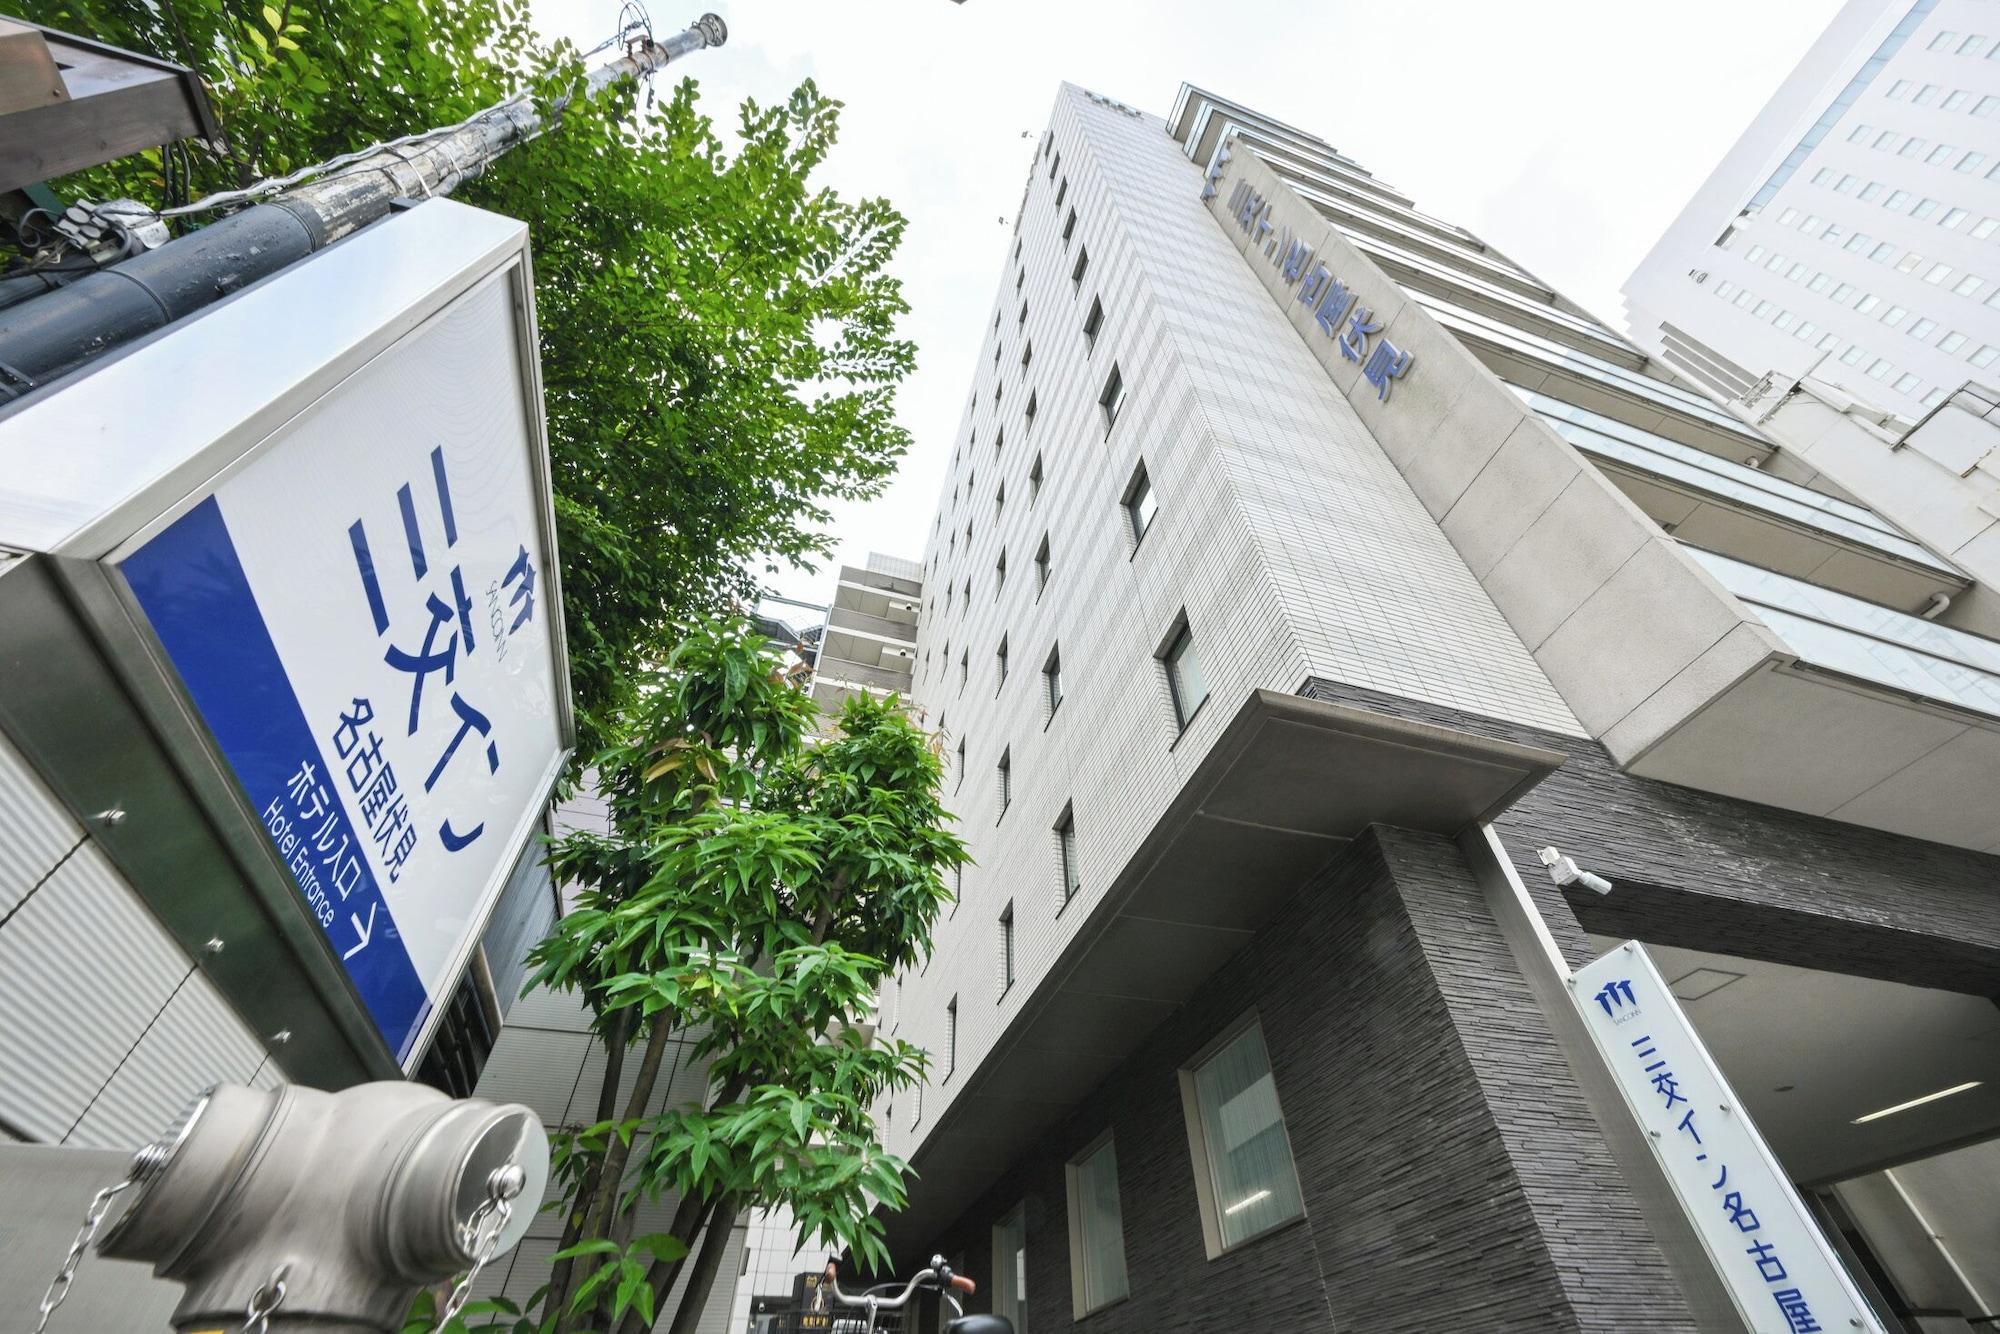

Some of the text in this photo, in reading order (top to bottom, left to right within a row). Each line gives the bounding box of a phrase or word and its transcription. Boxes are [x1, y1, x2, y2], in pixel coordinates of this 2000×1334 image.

[348, 444, 499, 853] 三交イン
[262, 795, 335, 928] Hotel Entrance
[287, 760, 362, 902] ホテル入口
[332, 697, 424, 883] 名古屋伏見
